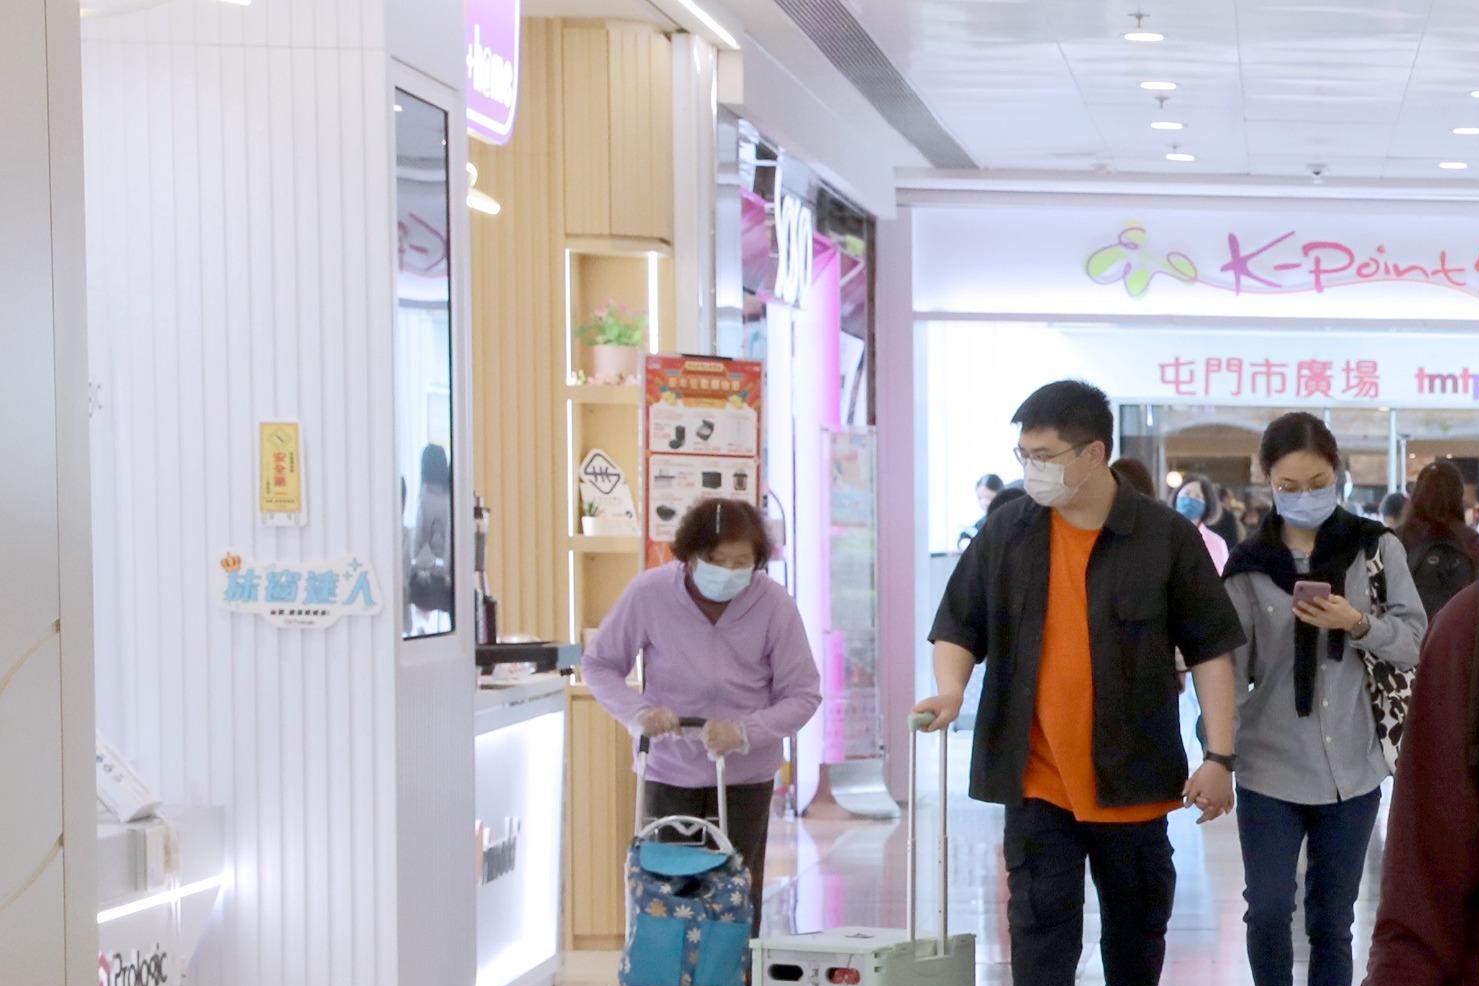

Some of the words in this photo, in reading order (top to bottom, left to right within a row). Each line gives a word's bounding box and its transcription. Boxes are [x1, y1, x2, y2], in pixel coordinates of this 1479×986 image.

[1220, 230, 1468, 296] K-Point
[1158, 356, 1381, 399] 屯門市廣場
